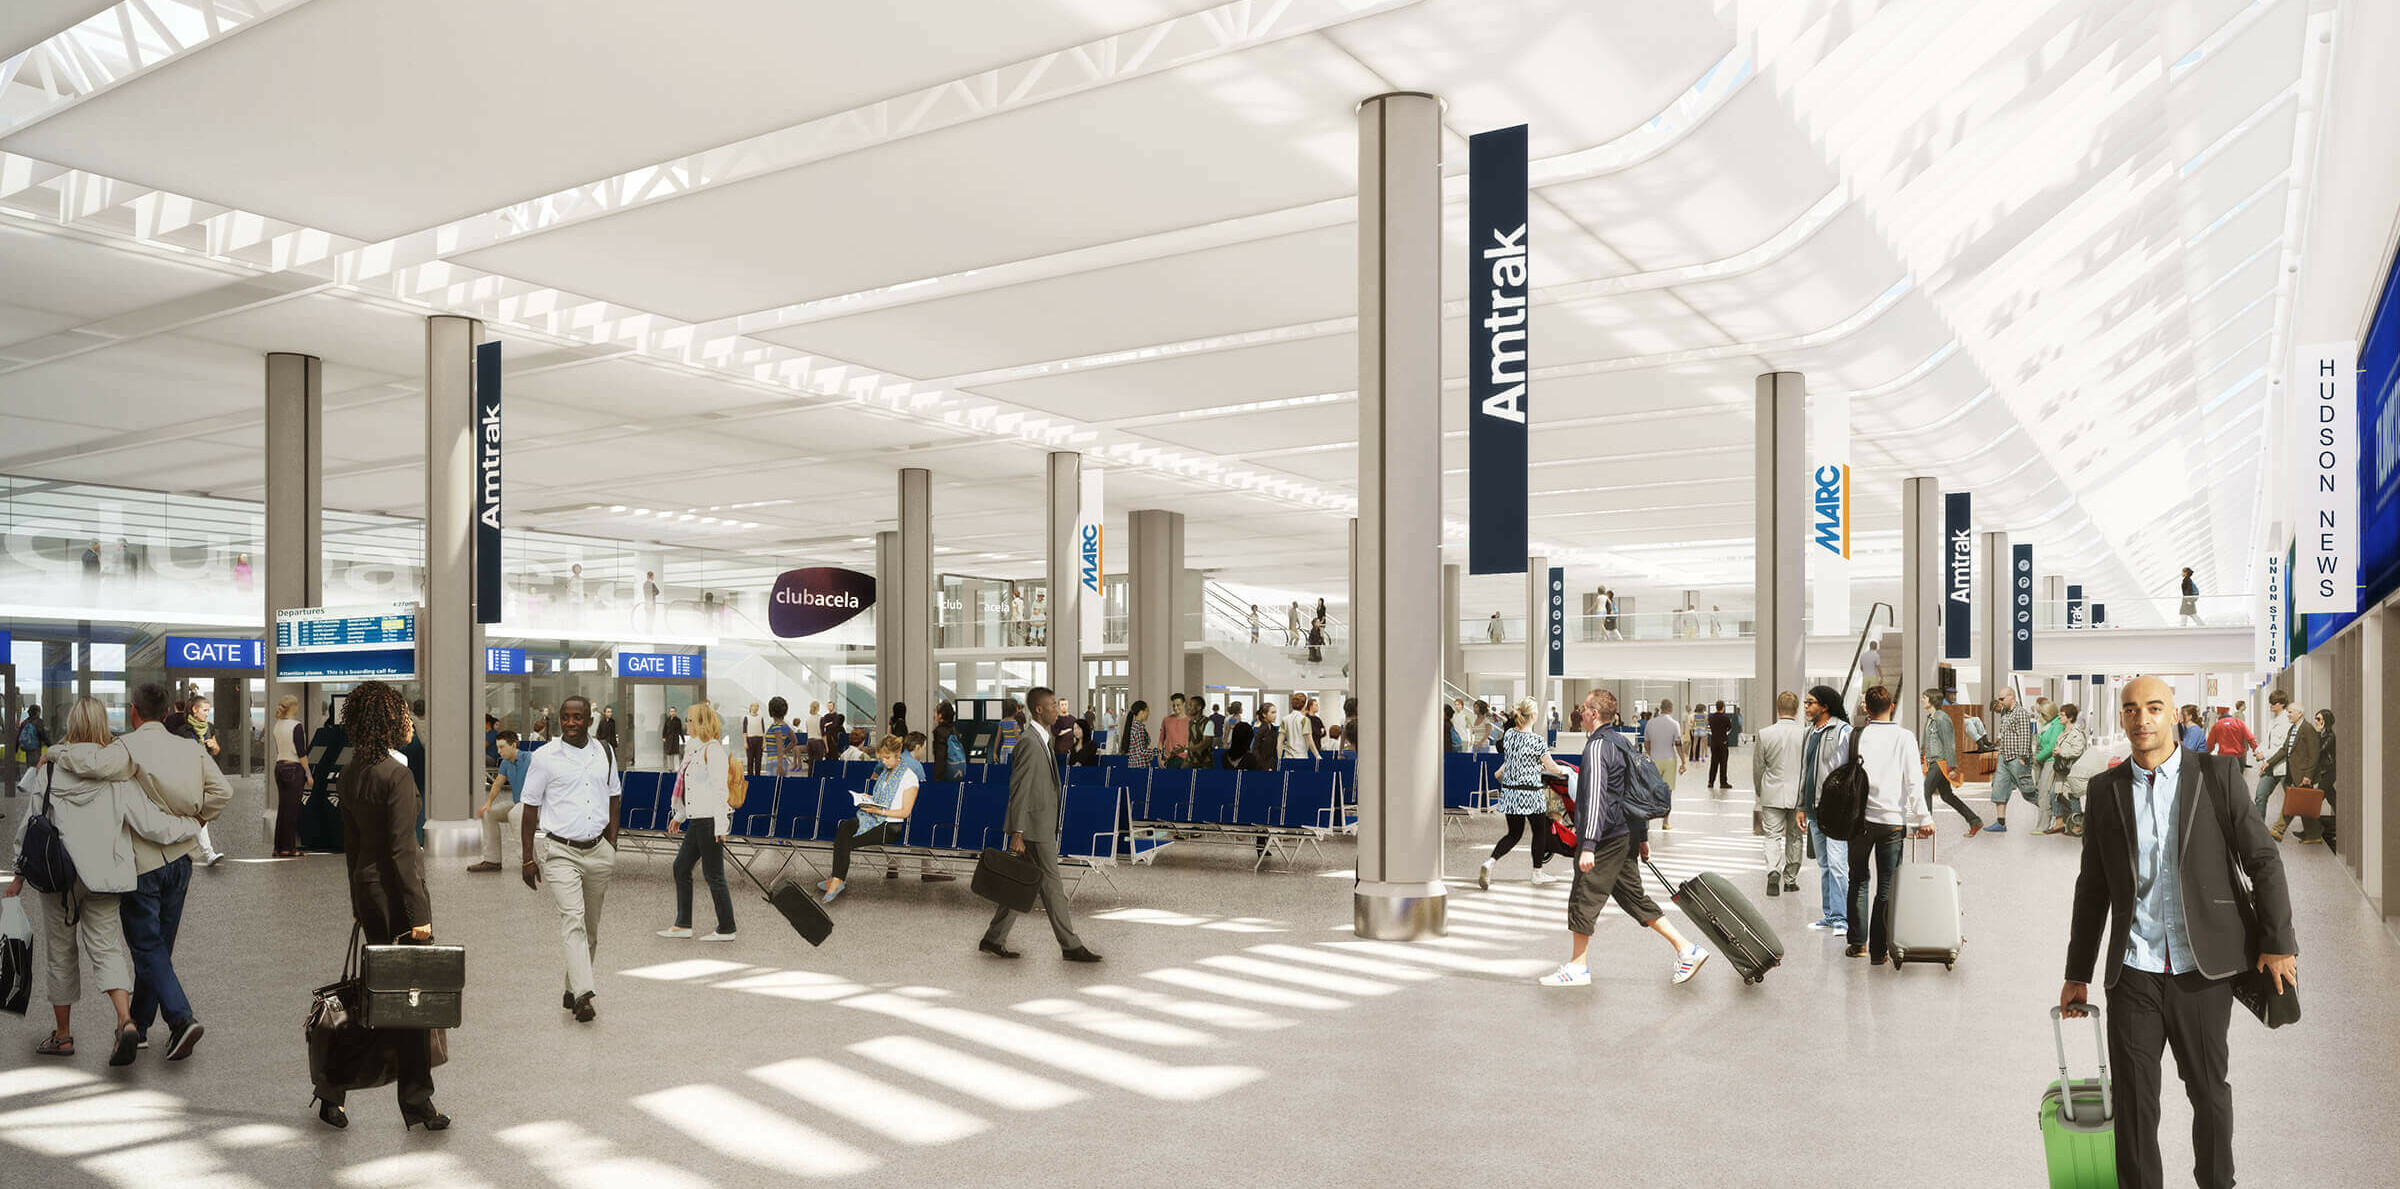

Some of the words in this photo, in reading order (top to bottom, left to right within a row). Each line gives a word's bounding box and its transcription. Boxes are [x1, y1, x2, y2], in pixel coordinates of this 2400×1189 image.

[1481, 222, 1527, 425] Amtrak
[2319, 358, 2336, 492] HUDSON
[481, 402, 500, 530] Amtrak
[1815, 464, 1841, 556] MARC
[1082, 524, 1098, 593] MARC
[1950, 528, 1970, 604] Amtrak
[2269, 557, 2278, 601] UNION
[2316, 510, 2338, 598] NEWS
[277, 608, 325, 617] Departures
[776, 587, 859, 609] clubacela
[183, 642, 241, 662] GATE
[628, 656, 665, 672] GATE
[2269, 606, 2278, 662] STATION
